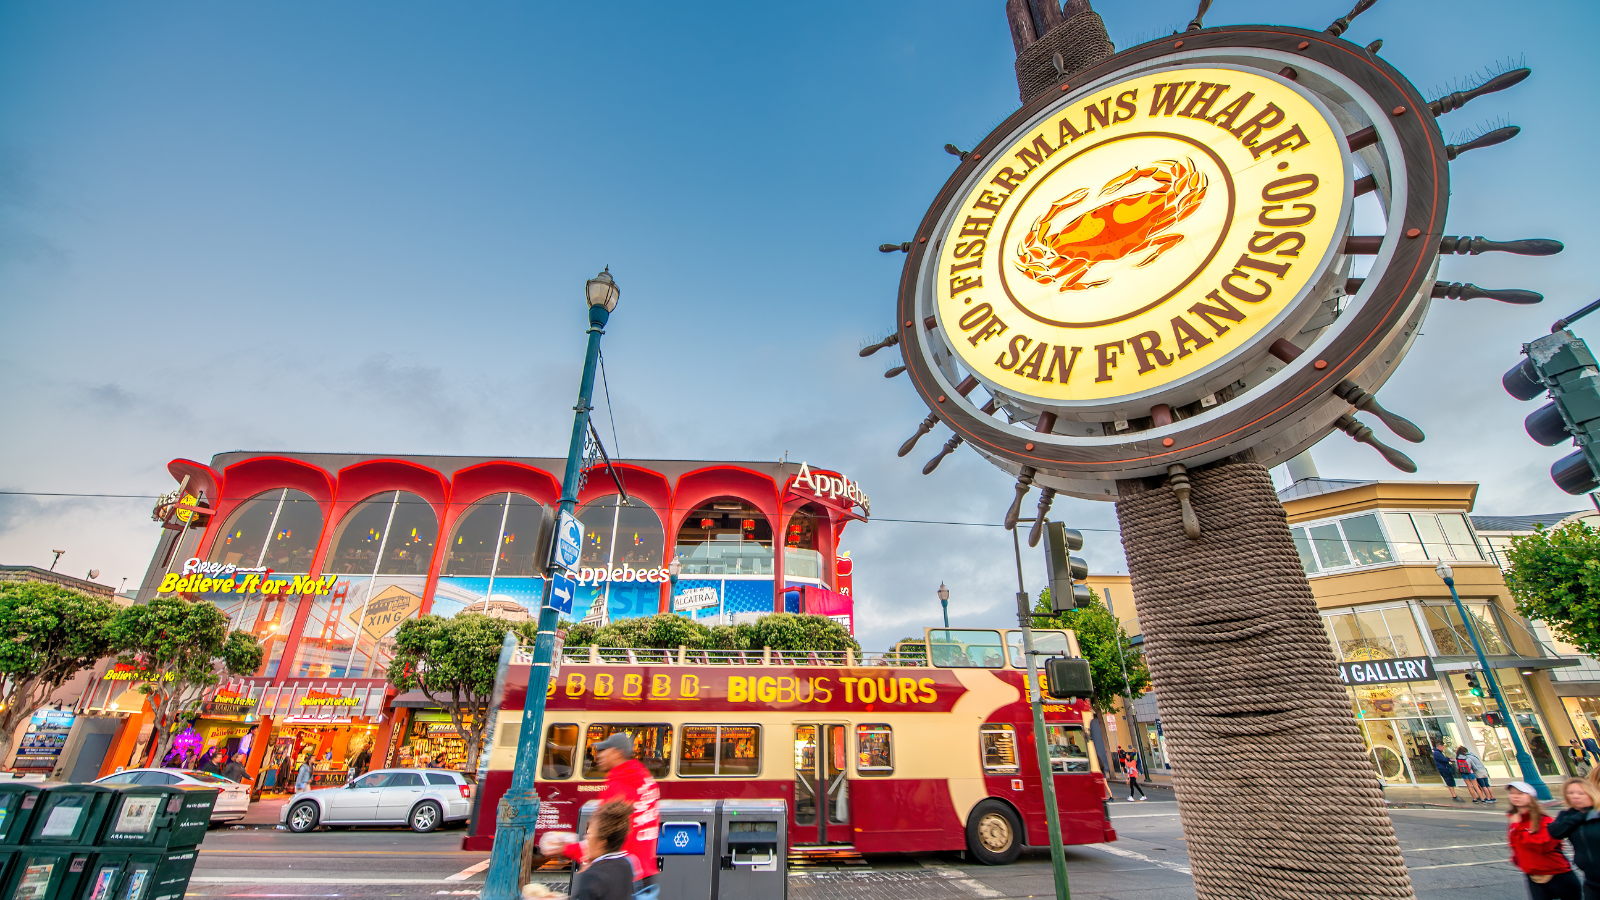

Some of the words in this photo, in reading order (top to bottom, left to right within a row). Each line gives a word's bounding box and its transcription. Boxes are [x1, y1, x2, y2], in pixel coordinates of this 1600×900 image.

[950, 88, 1138, 299] FISHERMANS
[1149, 80, 1311, 161] WHARF
[958, 302, 1008, 347] OF
[994, 334, 1083, 384] SAN
[1094, 172, 1319, 384] FRANCISCO
[157, 573, 235, 594] Believe
[236, 574, 260, 594] It
[261, 579, 287, 595] or
[286, 574, 338, 595] Not!
[612, 586, 657, 615] SF
[368, 611, 402, 627] XING
[1350, 659, 1428, 682] GALLERY
[839, 676, 938, 704] TOURS
